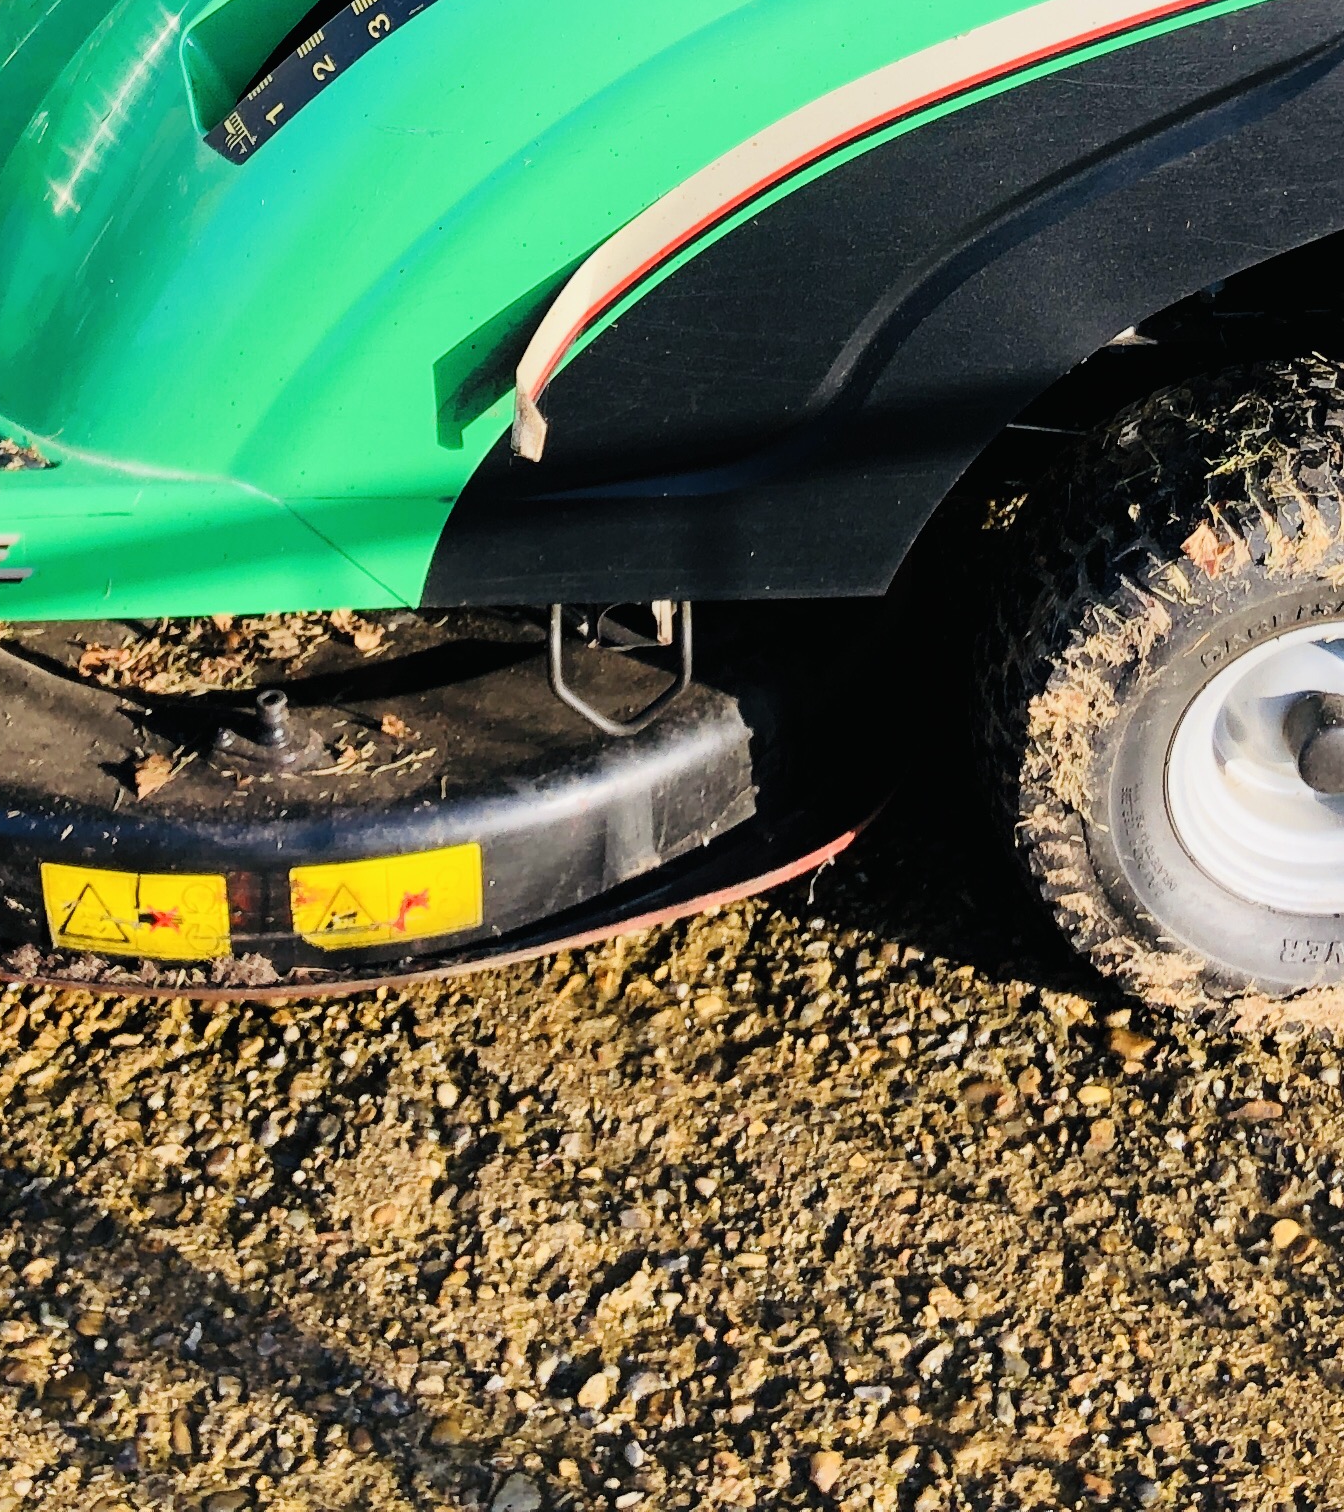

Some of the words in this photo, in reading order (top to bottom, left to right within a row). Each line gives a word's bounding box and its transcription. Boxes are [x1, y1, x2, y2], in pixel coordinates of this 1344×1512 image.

[264, 102, 285, 126] 1
[311, 53, 337, 82] 2
[367, 13, 393, 39] 3
